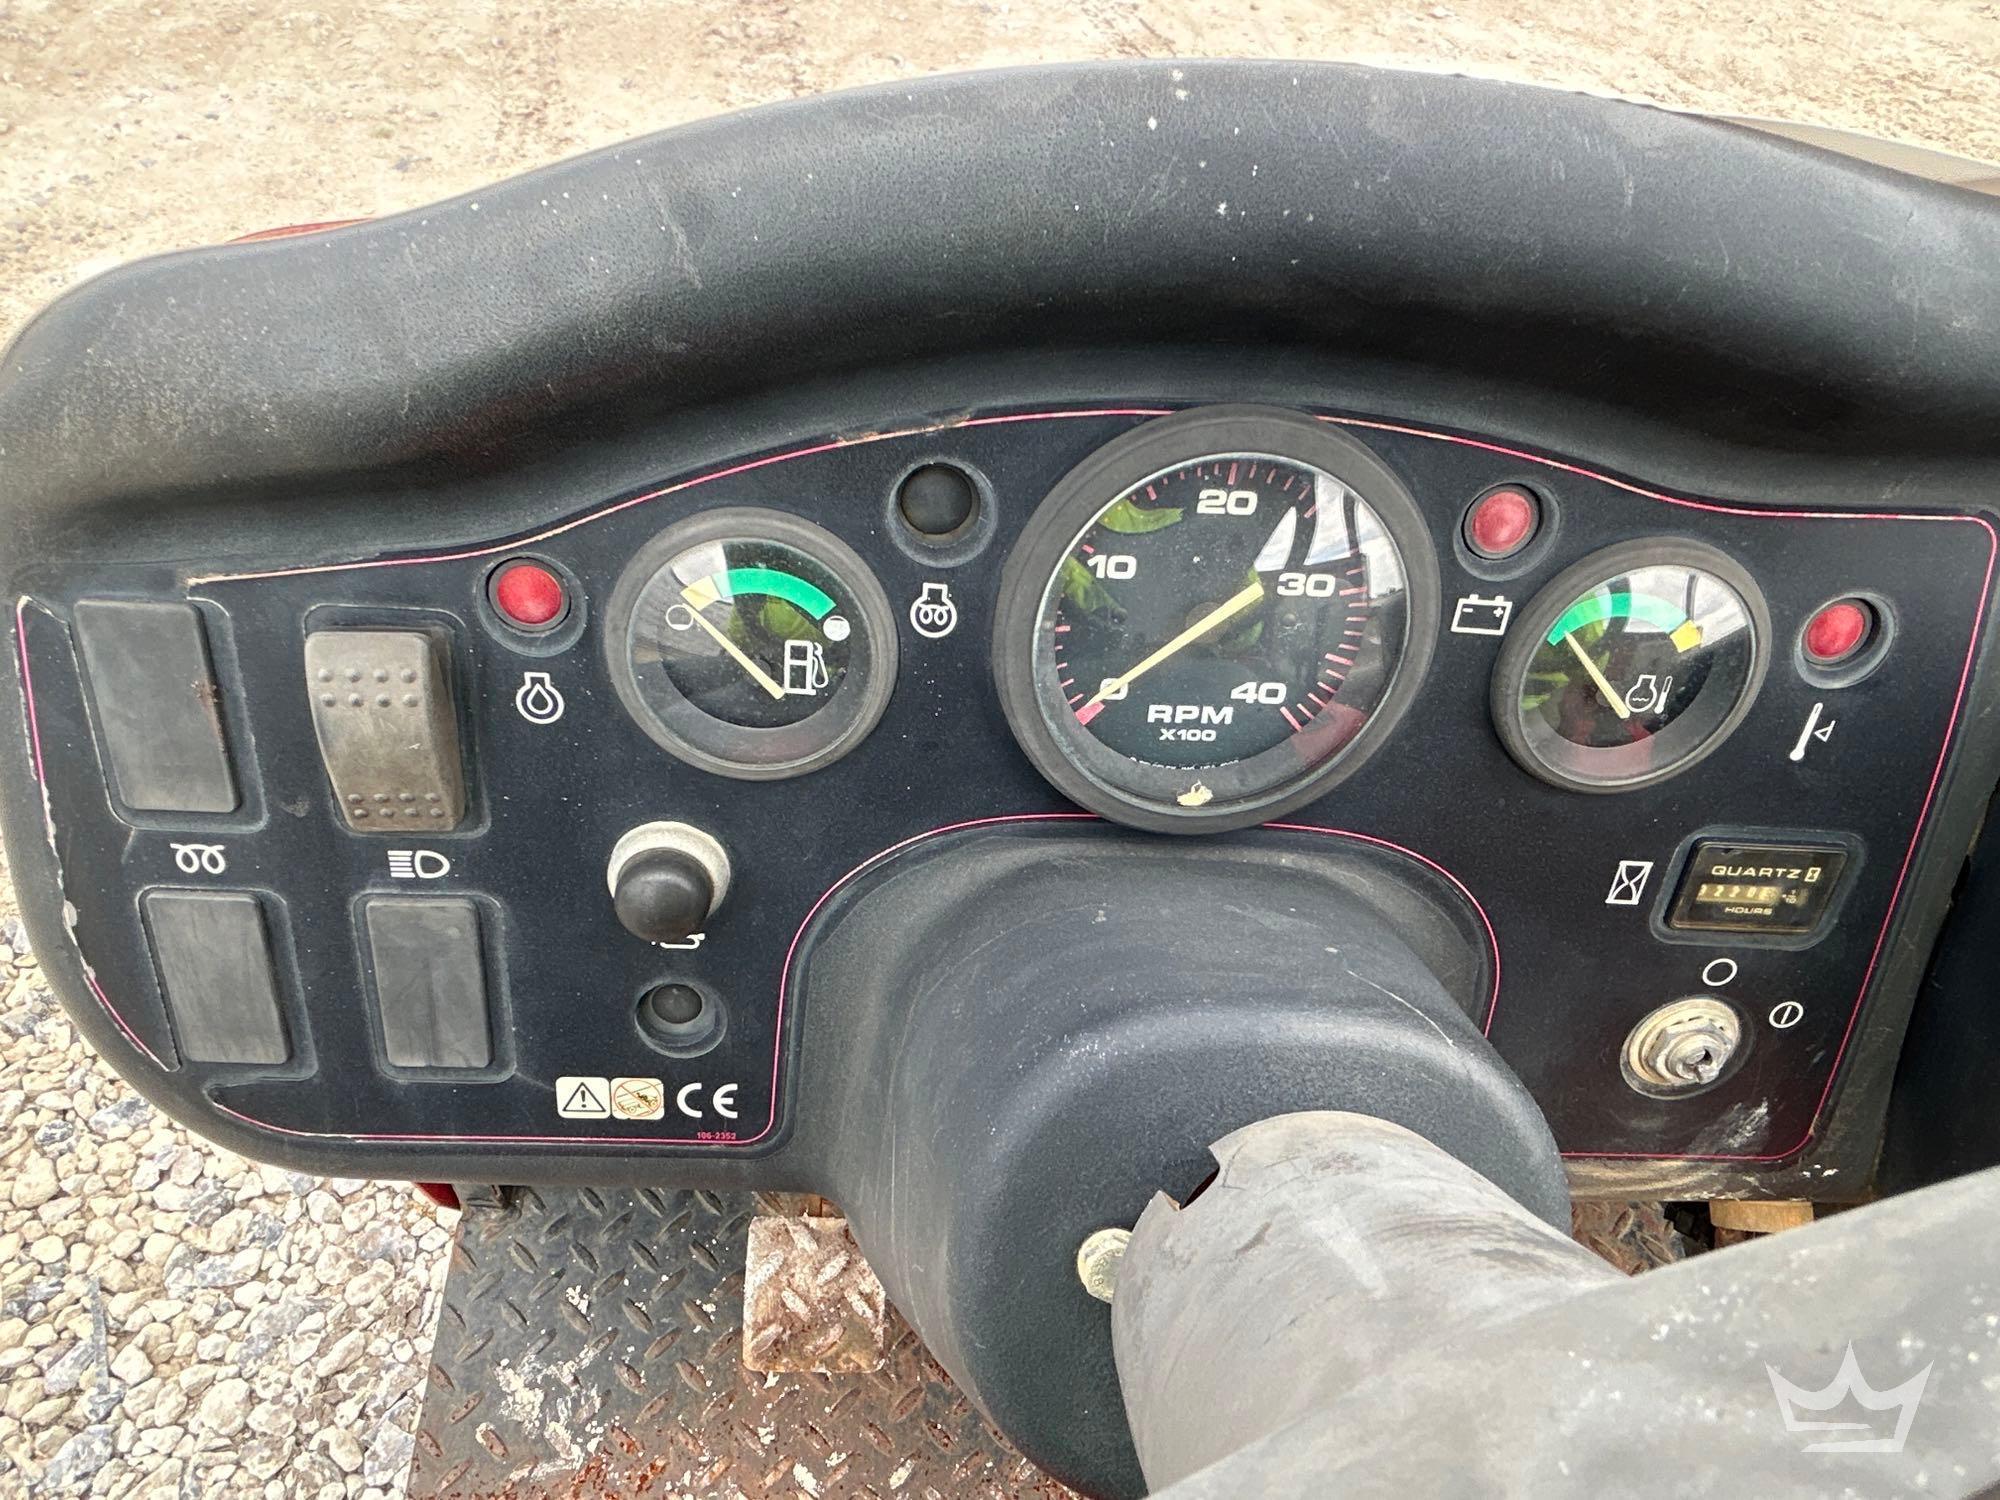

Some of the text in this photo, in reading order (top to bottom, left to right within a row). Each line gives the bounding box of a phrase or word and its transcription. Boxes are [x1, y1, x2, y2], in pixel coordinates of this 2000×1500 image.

[1197, 489, 1257, 515] 20
[1087, 555, 1137, 579] 10
[1277, 573, 1335, 597] 30
[1100, 678, 1128, 700] 0
[1230, 682, 1287, 704] 40
[1147, 705, 1233, 724] RPM
[1159, 729, 1216, 741] X100
[1711, 865, 1802, 879] QUARTZ
[1724, 907, 1773, 915] HOURS
[677, 1082, 738, 1118] CE
